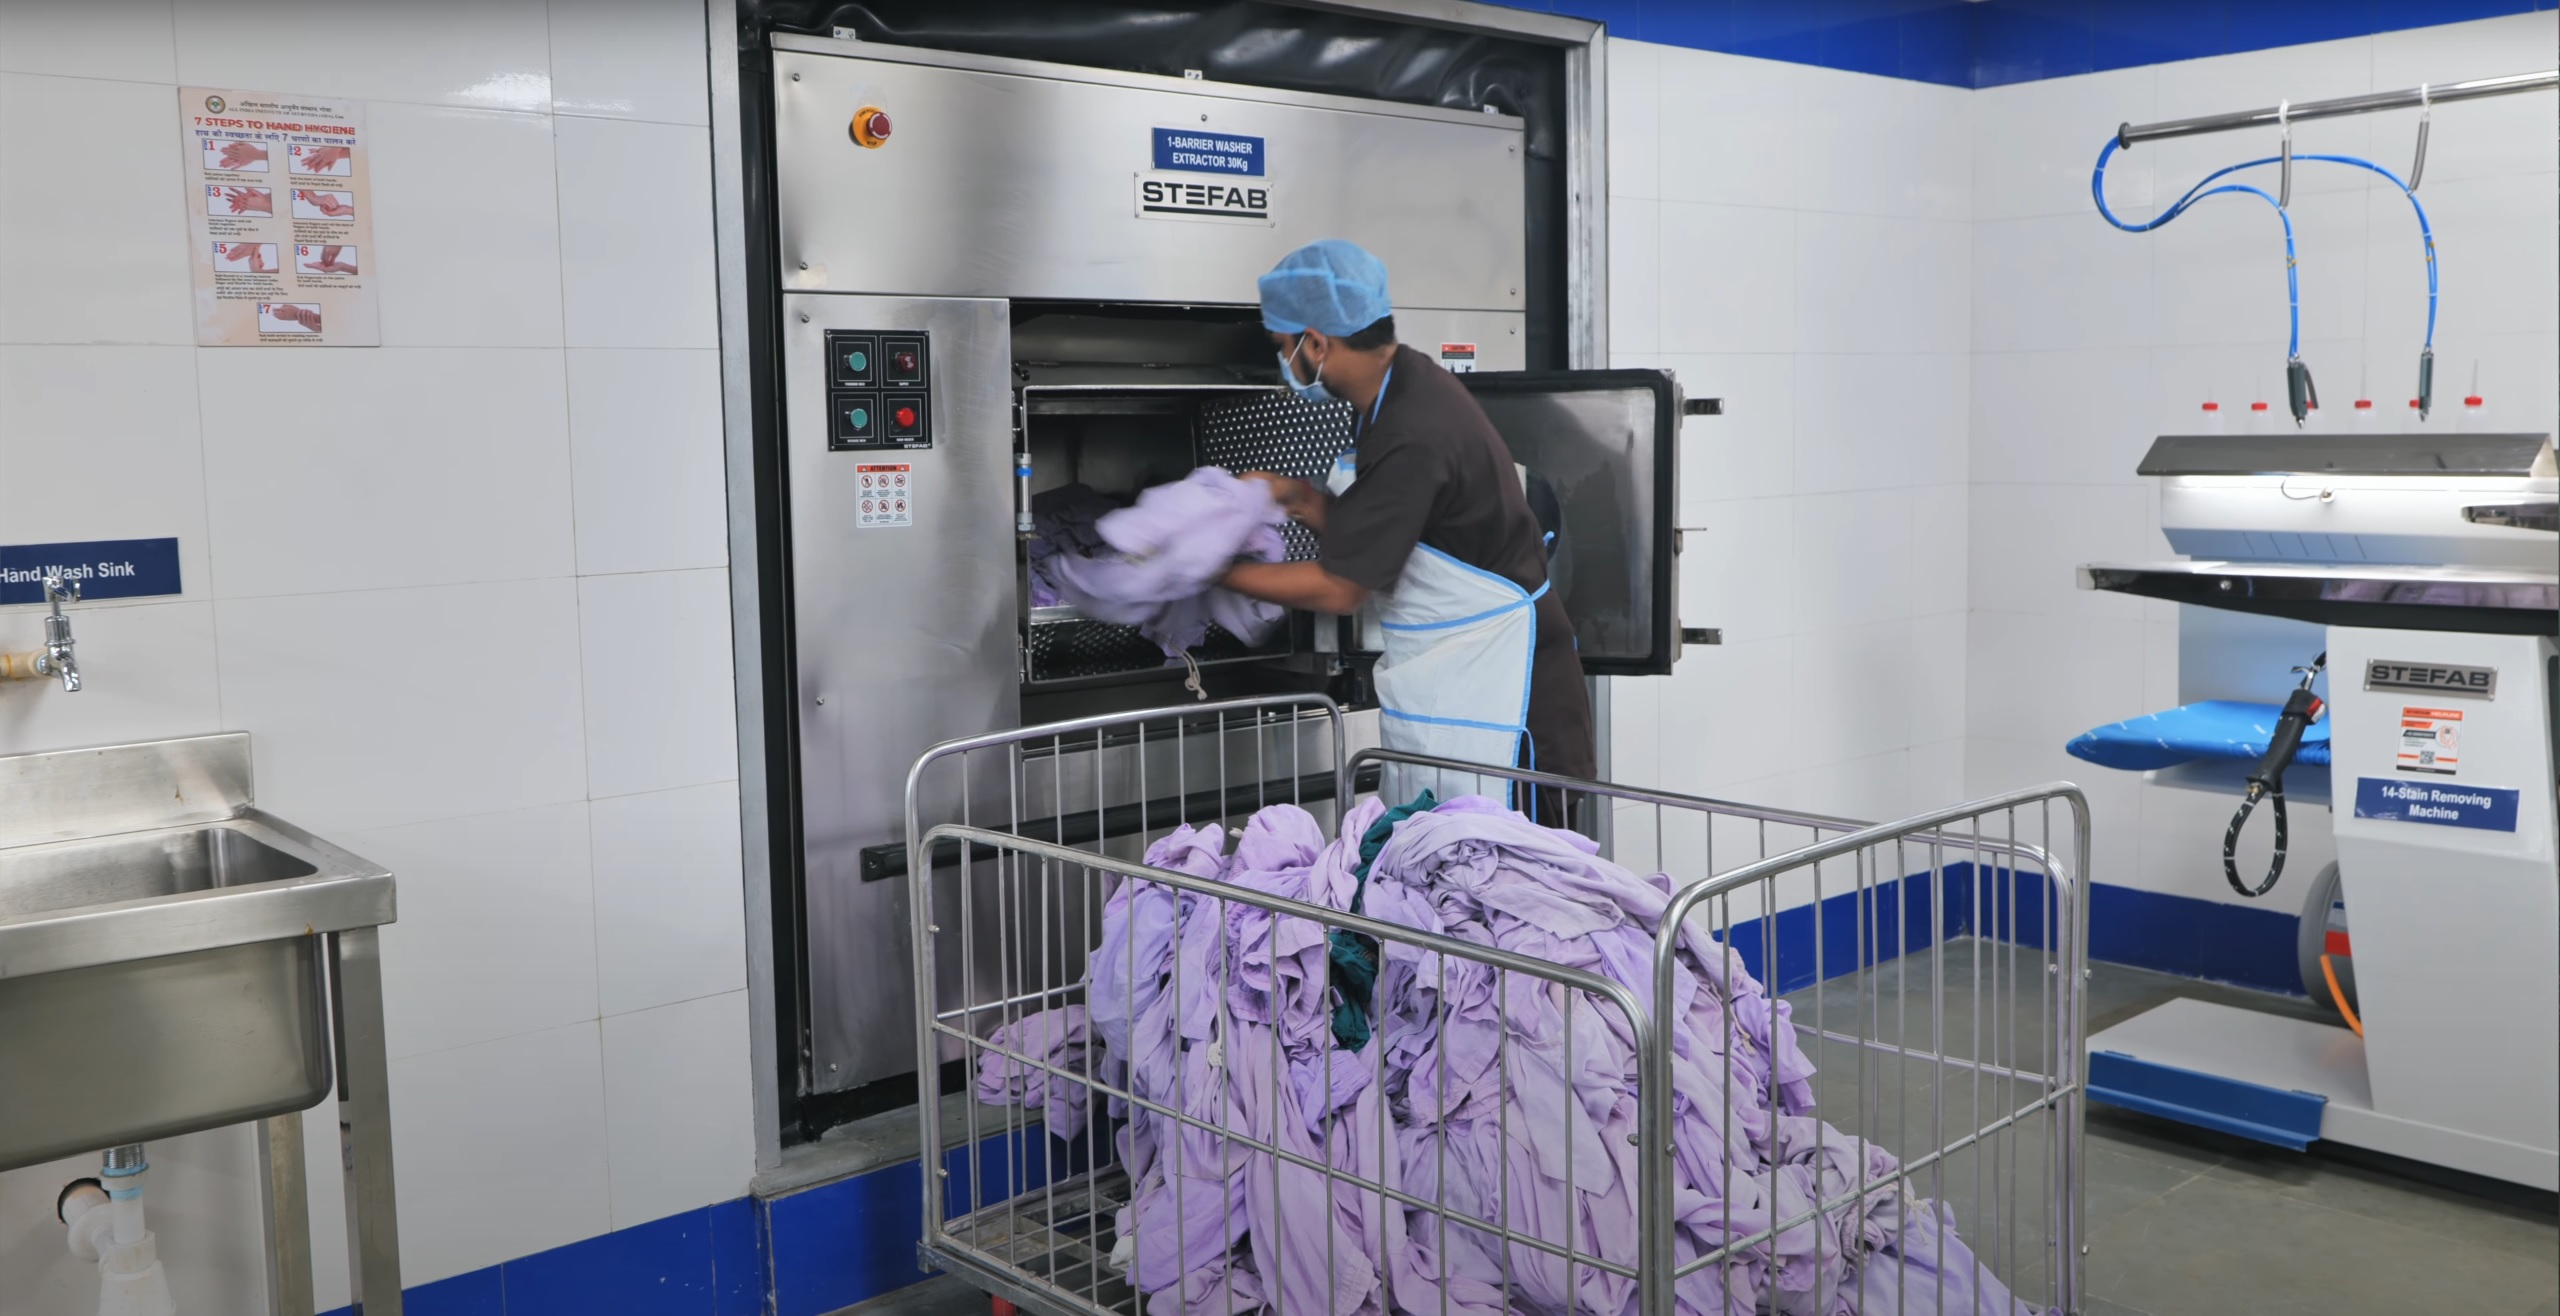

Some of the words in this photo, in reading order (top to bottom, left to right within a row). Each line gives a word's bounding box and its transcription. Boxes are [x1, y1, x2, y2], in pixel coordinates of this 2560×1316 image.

[194, 117, 202, 125] 7
[205, 118, 244, 128] STEPS
[246, 120, 264, 129] TO
[266, 122, 303, 132] HAND
[305, 124, 356, 135] HYGIENE
[209, 140, 215, 150] 1
[294, 146, 301, 156] 2
[1167, 136, 1214, 151] 1-BARRIER
[1215, 140, 1252, 154] WASHER
[1173, 152, 1226, 167] EXTRACTOR
[1227, 156, 1248, 172] 30Kg
[213, 186, 221, 197] 3
[297, 191, 305, 200] 4
[1142, 181, 1268, 210] STEFAB
[219, 244, 227, 254] 5
[301, 246, 309, 256] 6
[263, 304, 271, 314] 7
[0, 566, 42, 583] Hand
[45, 564, 93, 579] Wash
[98, 562, 135, 577] Sink
[2371, 665, 2490, 687] STEFAB
[2382, 786, 2428, 801] 14-Stain
[2431, 790, 2492, 809] Removing
[2409, 804, 2459, 820] Machine
